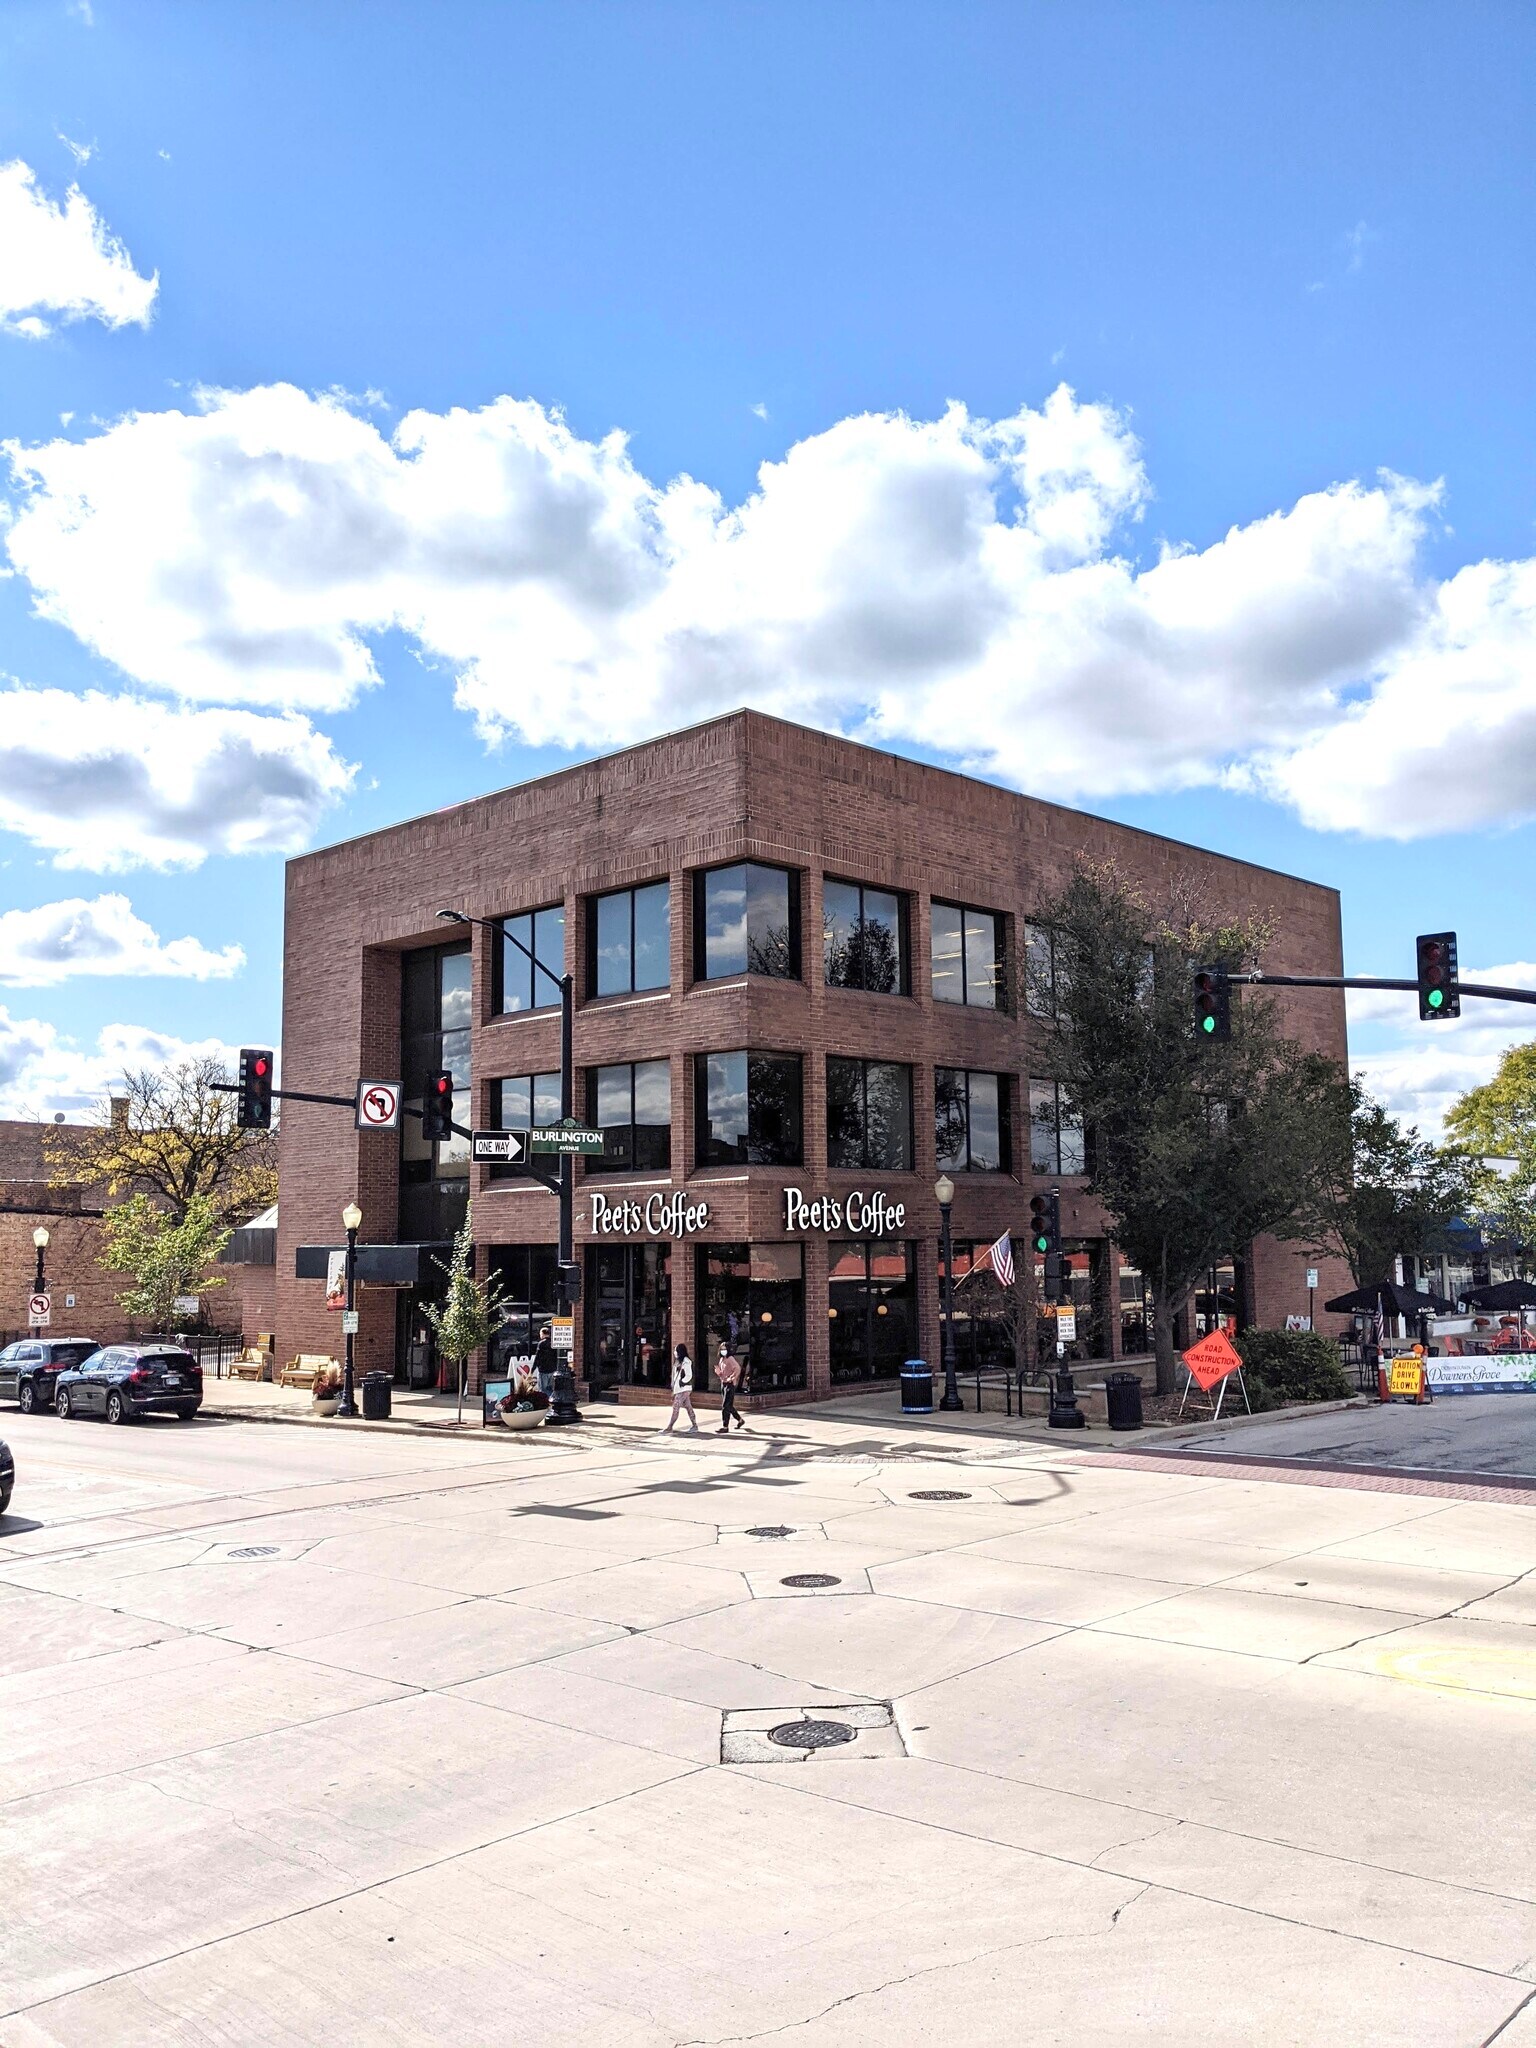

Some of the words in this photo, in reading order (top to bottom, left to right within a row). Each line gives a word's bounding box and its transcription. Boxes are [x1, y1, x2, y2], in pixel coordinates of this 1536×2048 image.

[532, 1131, 603, 1143] BURLINGTON
[478, 1141, 493, 1153] ONE
[494, 1141, 510, 1153] WAY
[590, 1193, 641, 1235] Peet's
[645, 1190, 710, 1239] Coffee
[783, 1187, 841, 1232] Peet's
[846, 1190, 906, 1237] Coffee
[1204, 1344, 1223, 1353] ROAD
[1187, 1353, 1236, 1365] CONSTRUCTION
[1393, 1361, 1421, 1369] CAUTION
[1197, 1366, 1220, 1375] AHEAD
[1396, 1371, 1415, 1379] DRIVE
[1429, 1366, 1472, 1381] Downers
[1472, 1365, 1500, 1381] Grove
[1392, 1381, 1419, 1390] SLOWLY
